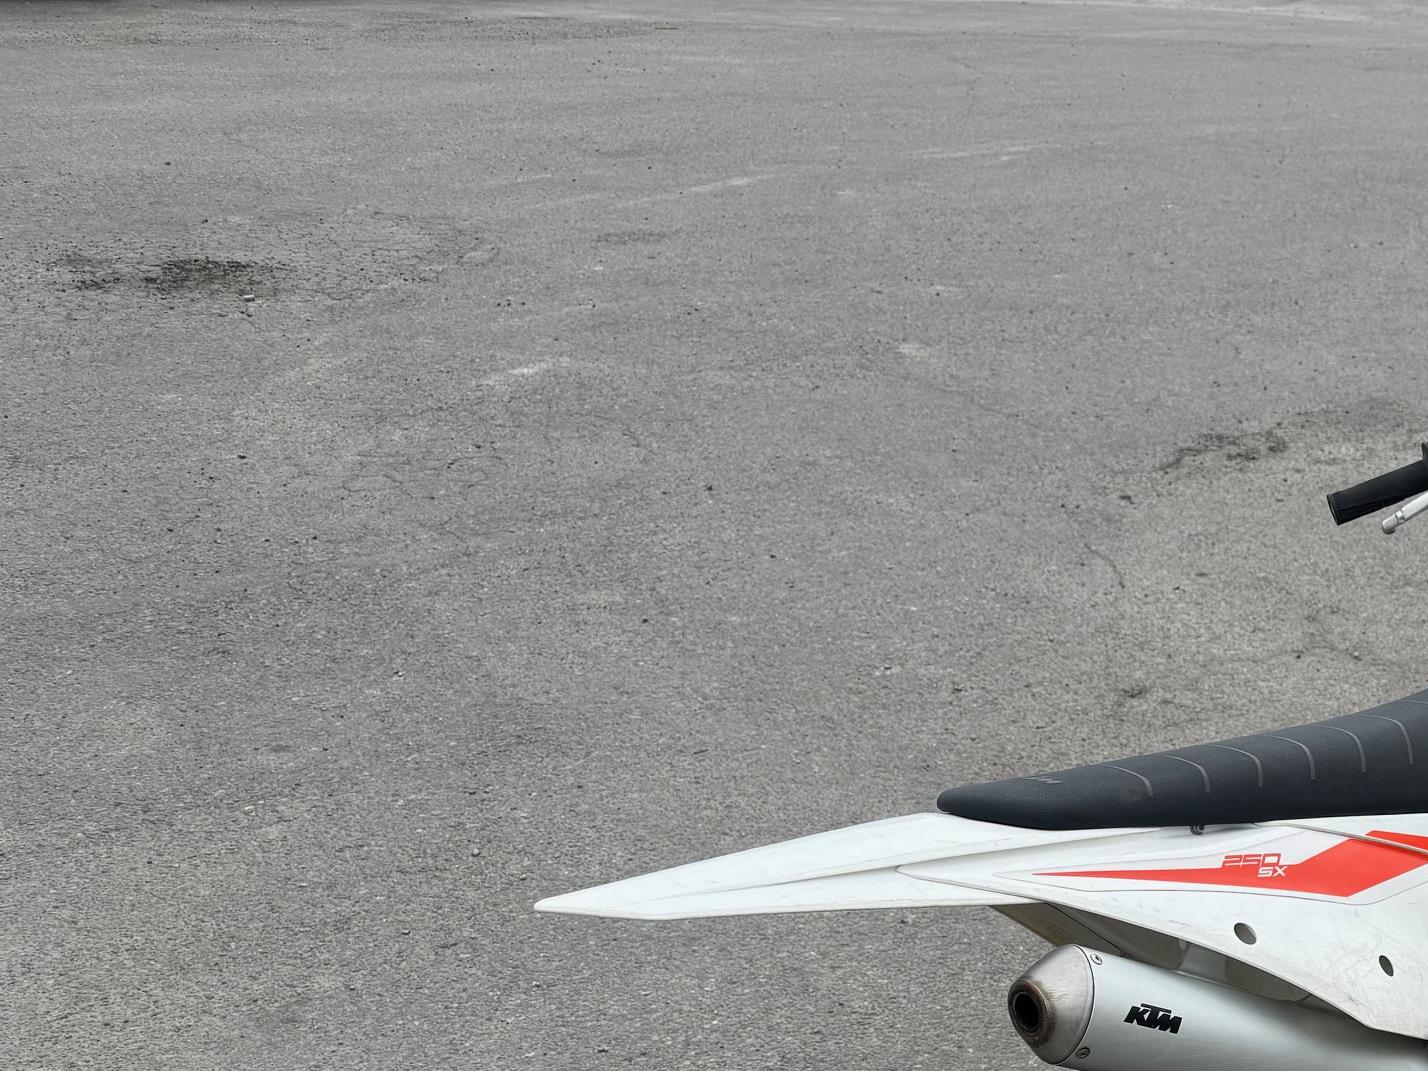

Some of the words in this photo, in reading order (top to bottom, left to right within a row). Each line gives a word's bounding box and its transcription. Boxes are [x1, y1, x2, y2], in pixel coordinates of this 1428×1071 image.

[1221, 853, 1281, 868] 250
[1257, 866, 1288, 877] SX
[1123, 1003, 1182, 1034] KTM
